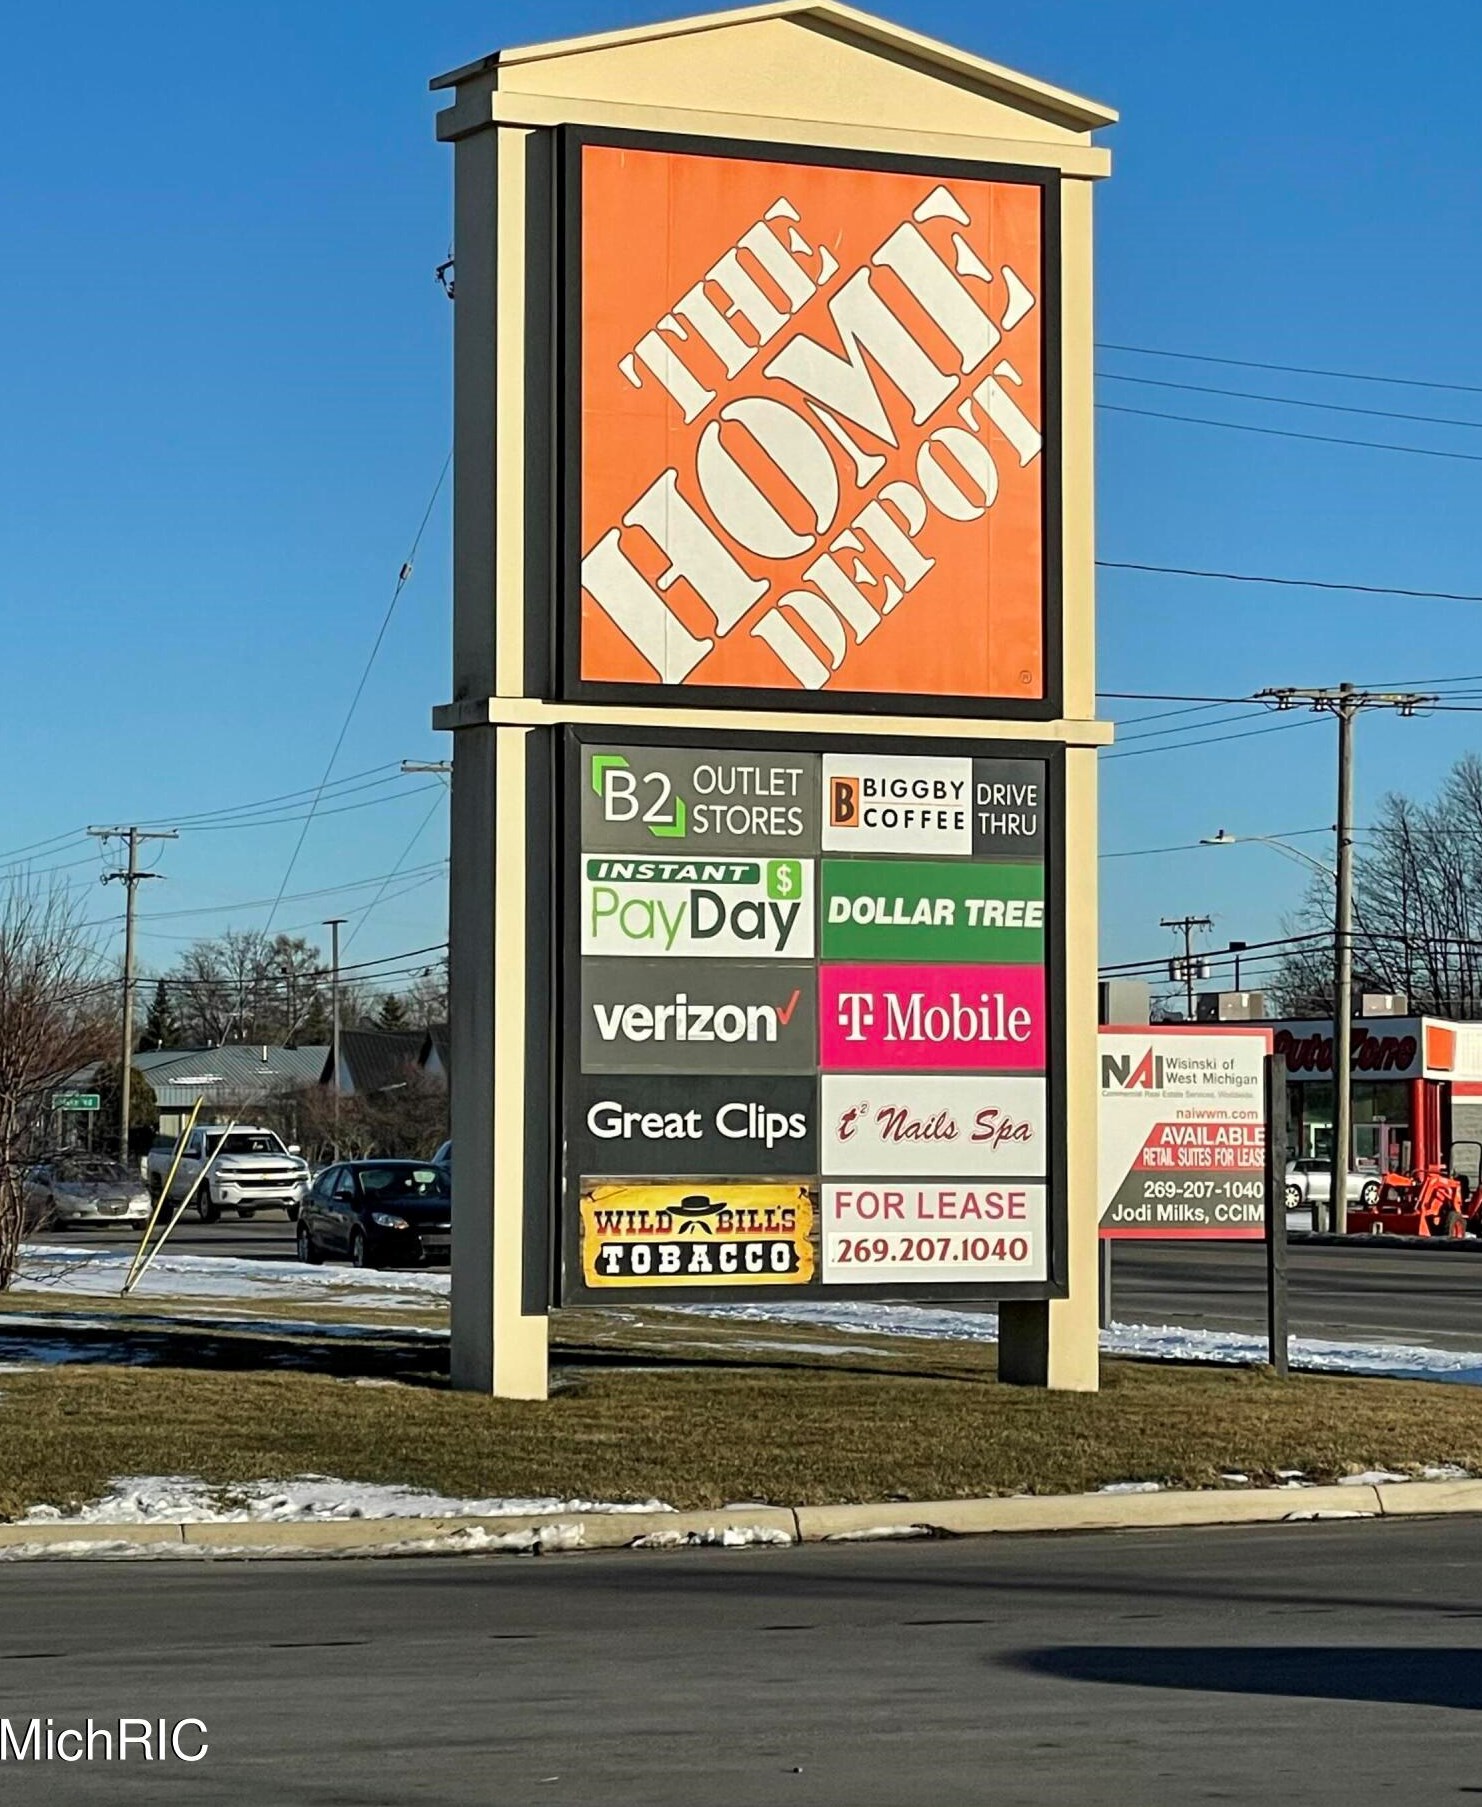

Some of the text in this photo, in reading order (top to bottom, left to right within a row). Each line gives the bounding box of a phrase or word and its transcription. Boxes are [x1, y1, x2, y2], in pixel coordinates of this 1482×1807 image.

[618, 196, 840, 425] THE
[581, 185, 1036, 685] HOME
[750, 359, 1043, 691] DEPOT
[603, 769, 675, 823] B2
[693, 765, 804, 798] OUTLET
[863, 778, 965, 800] BIGGBY
[976, 783, 1038, 807] DRIVE
[834, 781, 855, 823] B
[692, 805, 804, 837] STORES
[863, 808, 965, 830] COFFEE
[977, 812, 1038, 836] THRU
[597, 863, 750, 881] INSTANT
[591, 887, 801, 951] PayDay
[828, 896, 1045, 929] DOLLAR TREE
[592, 992, 777, 1042] verizon
[1102, 1046, 1164, 1089] NAI
[1165, 1057, 1235, 1070] Wisinski of
[1166, 1073, 1258, 1088] West Michigan
[586, 1100, 807, 1149] Great Clips
[876, 1107, 959, 1141] Nails
[971, 1109, 1033, 1149] Spa
[1176, 1107, 1259, 1120] naiwwm.com
[1160, 1126, 1265, 1146] AVAILABLE
[1142, 1147, 1176, 1167] RETAIL
[1177, 1147, 1212, 1167] SUITES
[1214, 1148, 1235, 1167] FOR
[1143, 1181, 1264, 1198] 269-207-1040
[593, 1205, 796, 1235] WILD BILL'S
[835, 1191, 1027, 1220] FOR LEASE
[1111, 1204, 1265, 1225] Jodi Milks, CCIM
[602, 1243, 791, 1274] TOBACCO
[836, 1238, 1028, 1263] 269.207.1040
